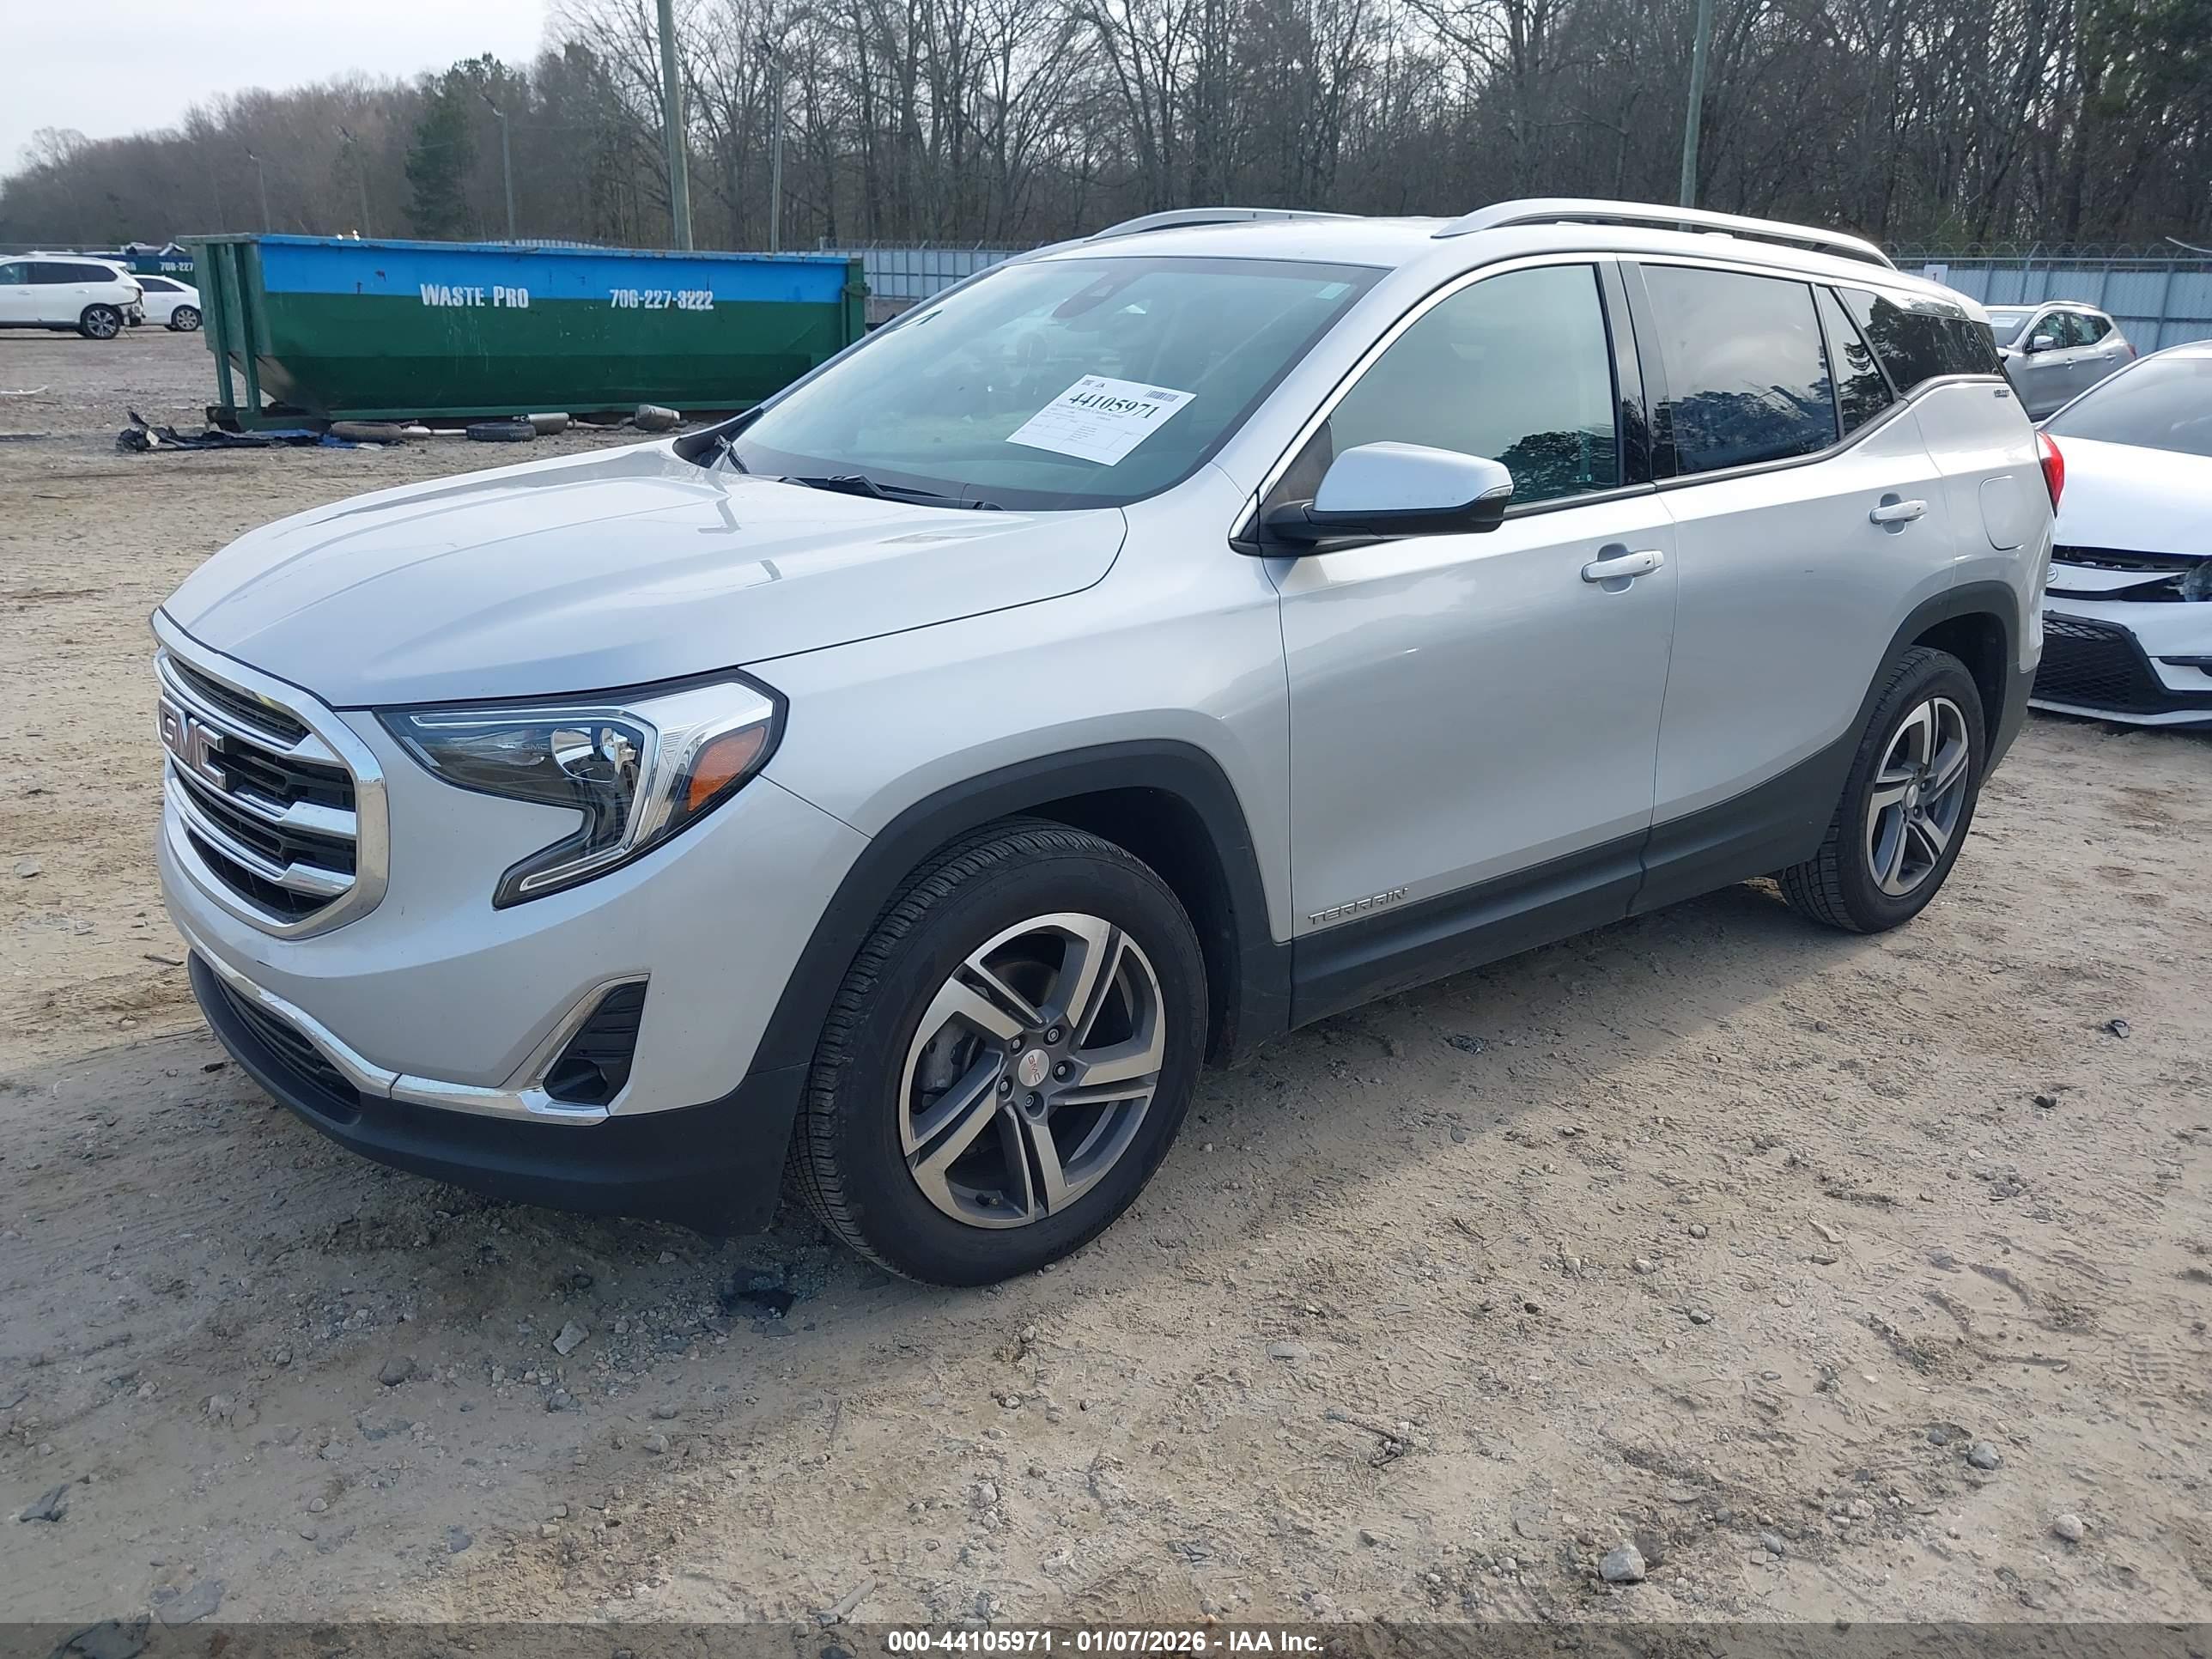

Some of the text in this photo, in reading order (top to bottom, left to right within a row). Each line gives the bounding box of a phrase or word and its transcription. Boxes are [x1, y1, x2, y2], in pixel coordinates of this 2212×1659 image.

[419, 283, 530, 309] WASTE PRO
[608, 288, 714, 311] 706-227-3222
[1069, 392, 1160, 419] 44105971
[158, 696, 227, 791] GMC
[1307, 886, 1409, 925] TERRAIN
[1028, 1054, 1042, 1083] GMC
